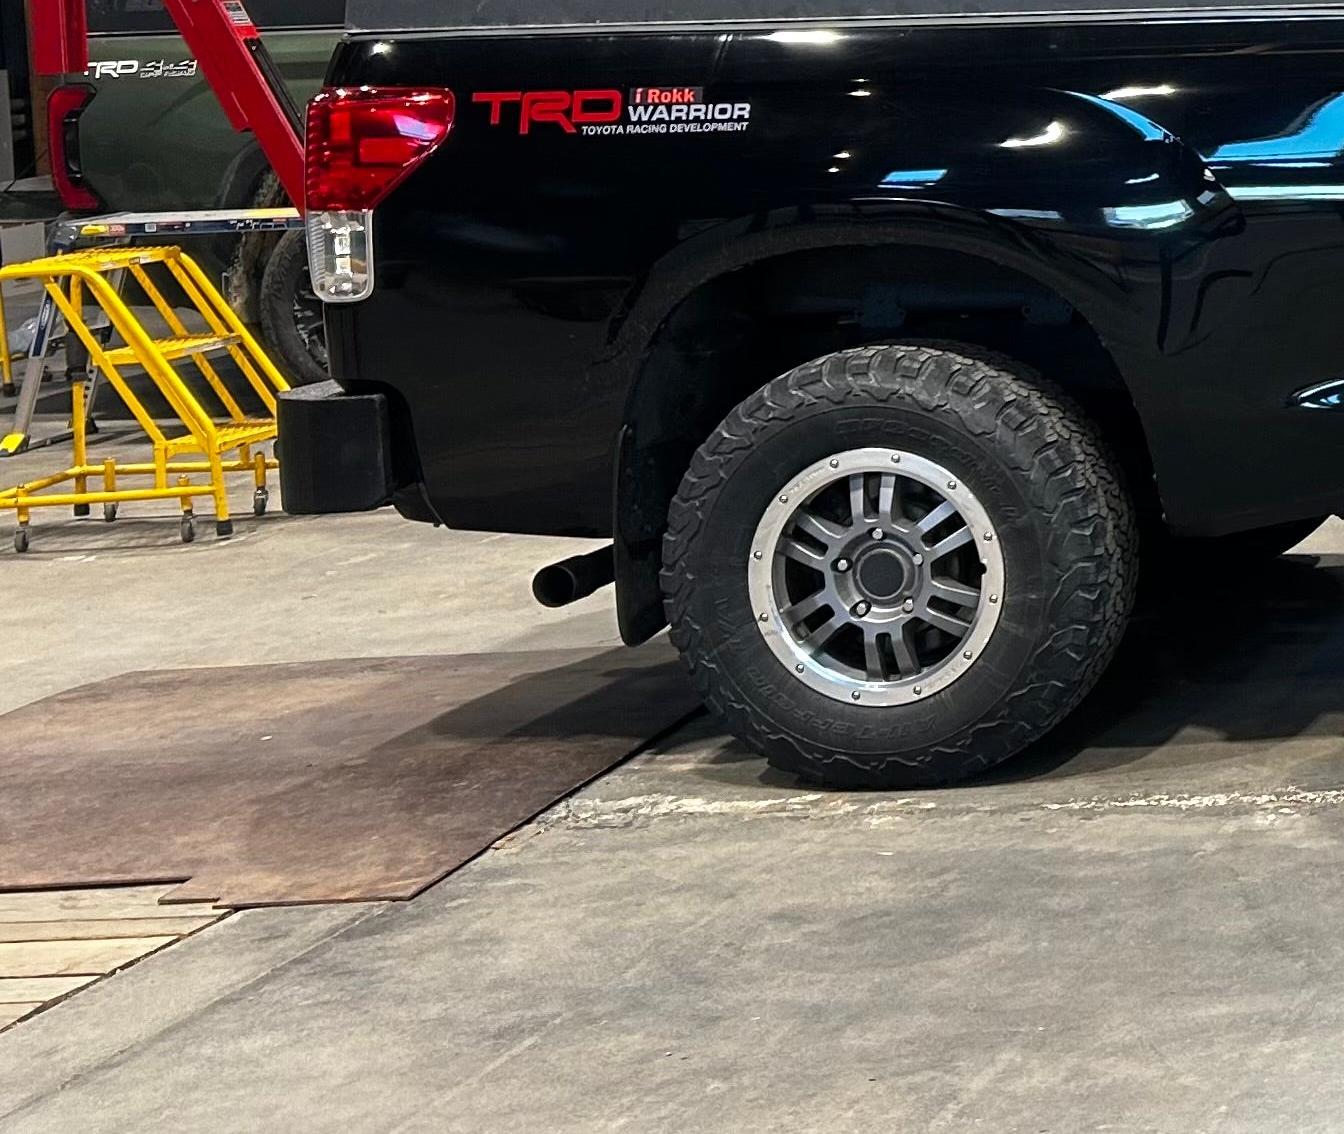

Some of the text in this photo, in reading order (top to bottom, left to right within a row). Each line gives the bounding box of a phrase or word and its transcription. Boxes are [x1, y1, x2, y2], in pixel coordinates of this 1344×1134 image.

[647, 88, 696, 104] Rokk
[472, 90, 621, 135] TRD
[627, 103, 751, 122] WARRIOR
[581, 121, 749, 135] TOYOTA RACING DEVELOPMENT
